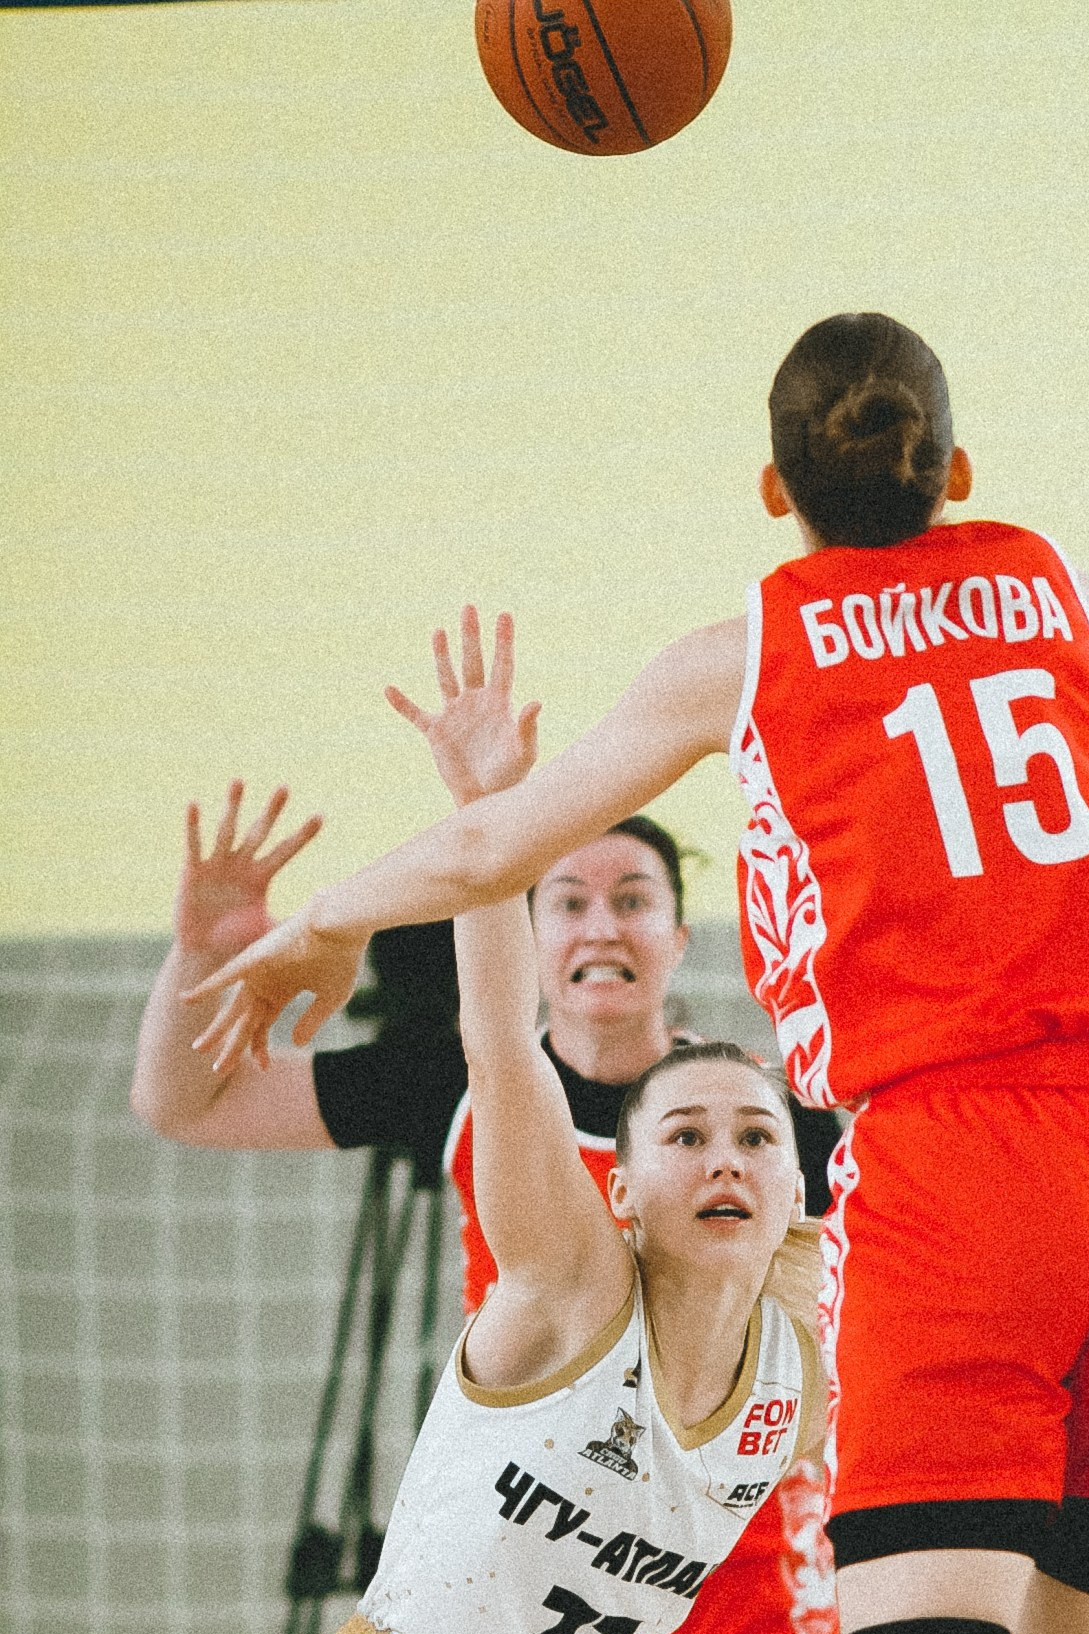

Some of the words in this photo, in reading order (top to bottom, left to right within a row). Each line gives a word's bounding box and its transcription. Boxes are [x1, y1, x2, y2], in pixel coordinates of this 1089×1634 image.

[533, 0, 608, 144] JÖGEL
[800, 573, 1074, 669] БОЙКОВА
[743, 1398, 798, 1428] FON
[737, 1427, 788, 1455] BET
[582, 1448, 637, 1480] ATLANTA
